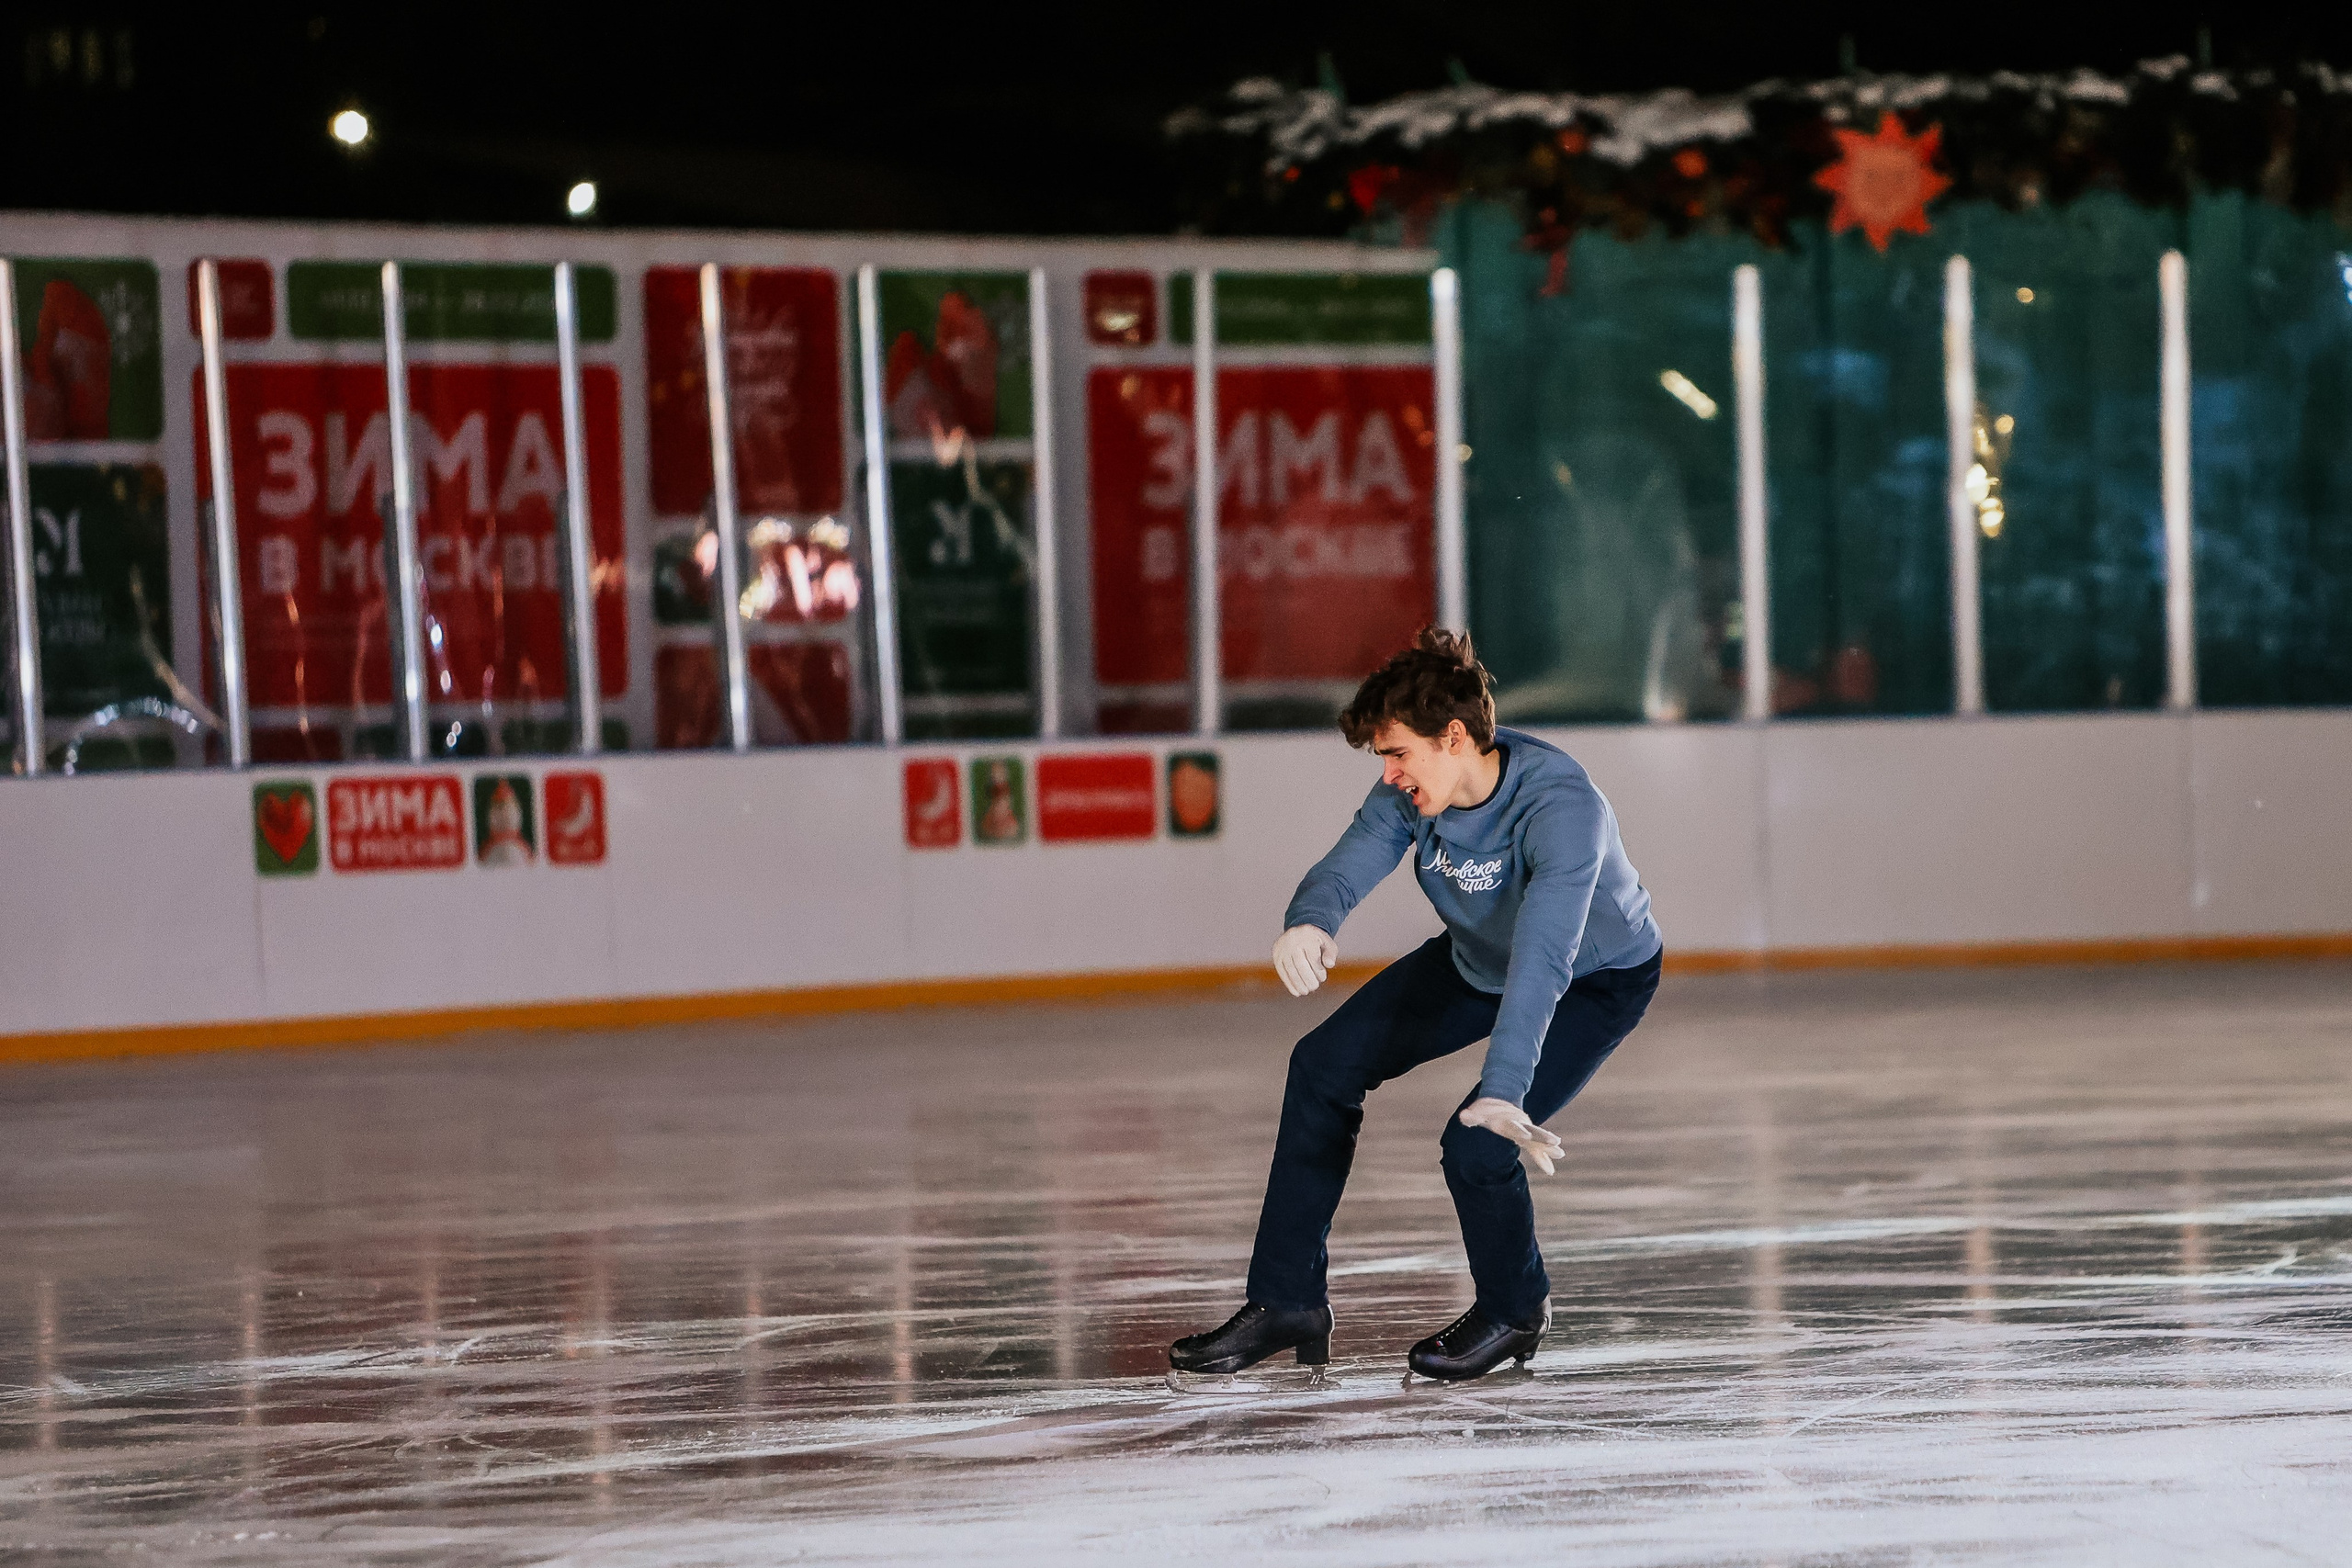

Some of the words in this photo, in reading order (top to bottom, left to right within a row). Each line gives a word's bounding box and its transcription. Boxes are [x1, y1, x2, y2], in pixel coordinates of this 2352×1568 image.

[256, 410, 570, 518] ЗИМА
[1143, 410, 1414, 507] ЗИМА
[334, 784, 458, 830] ЗИМА
